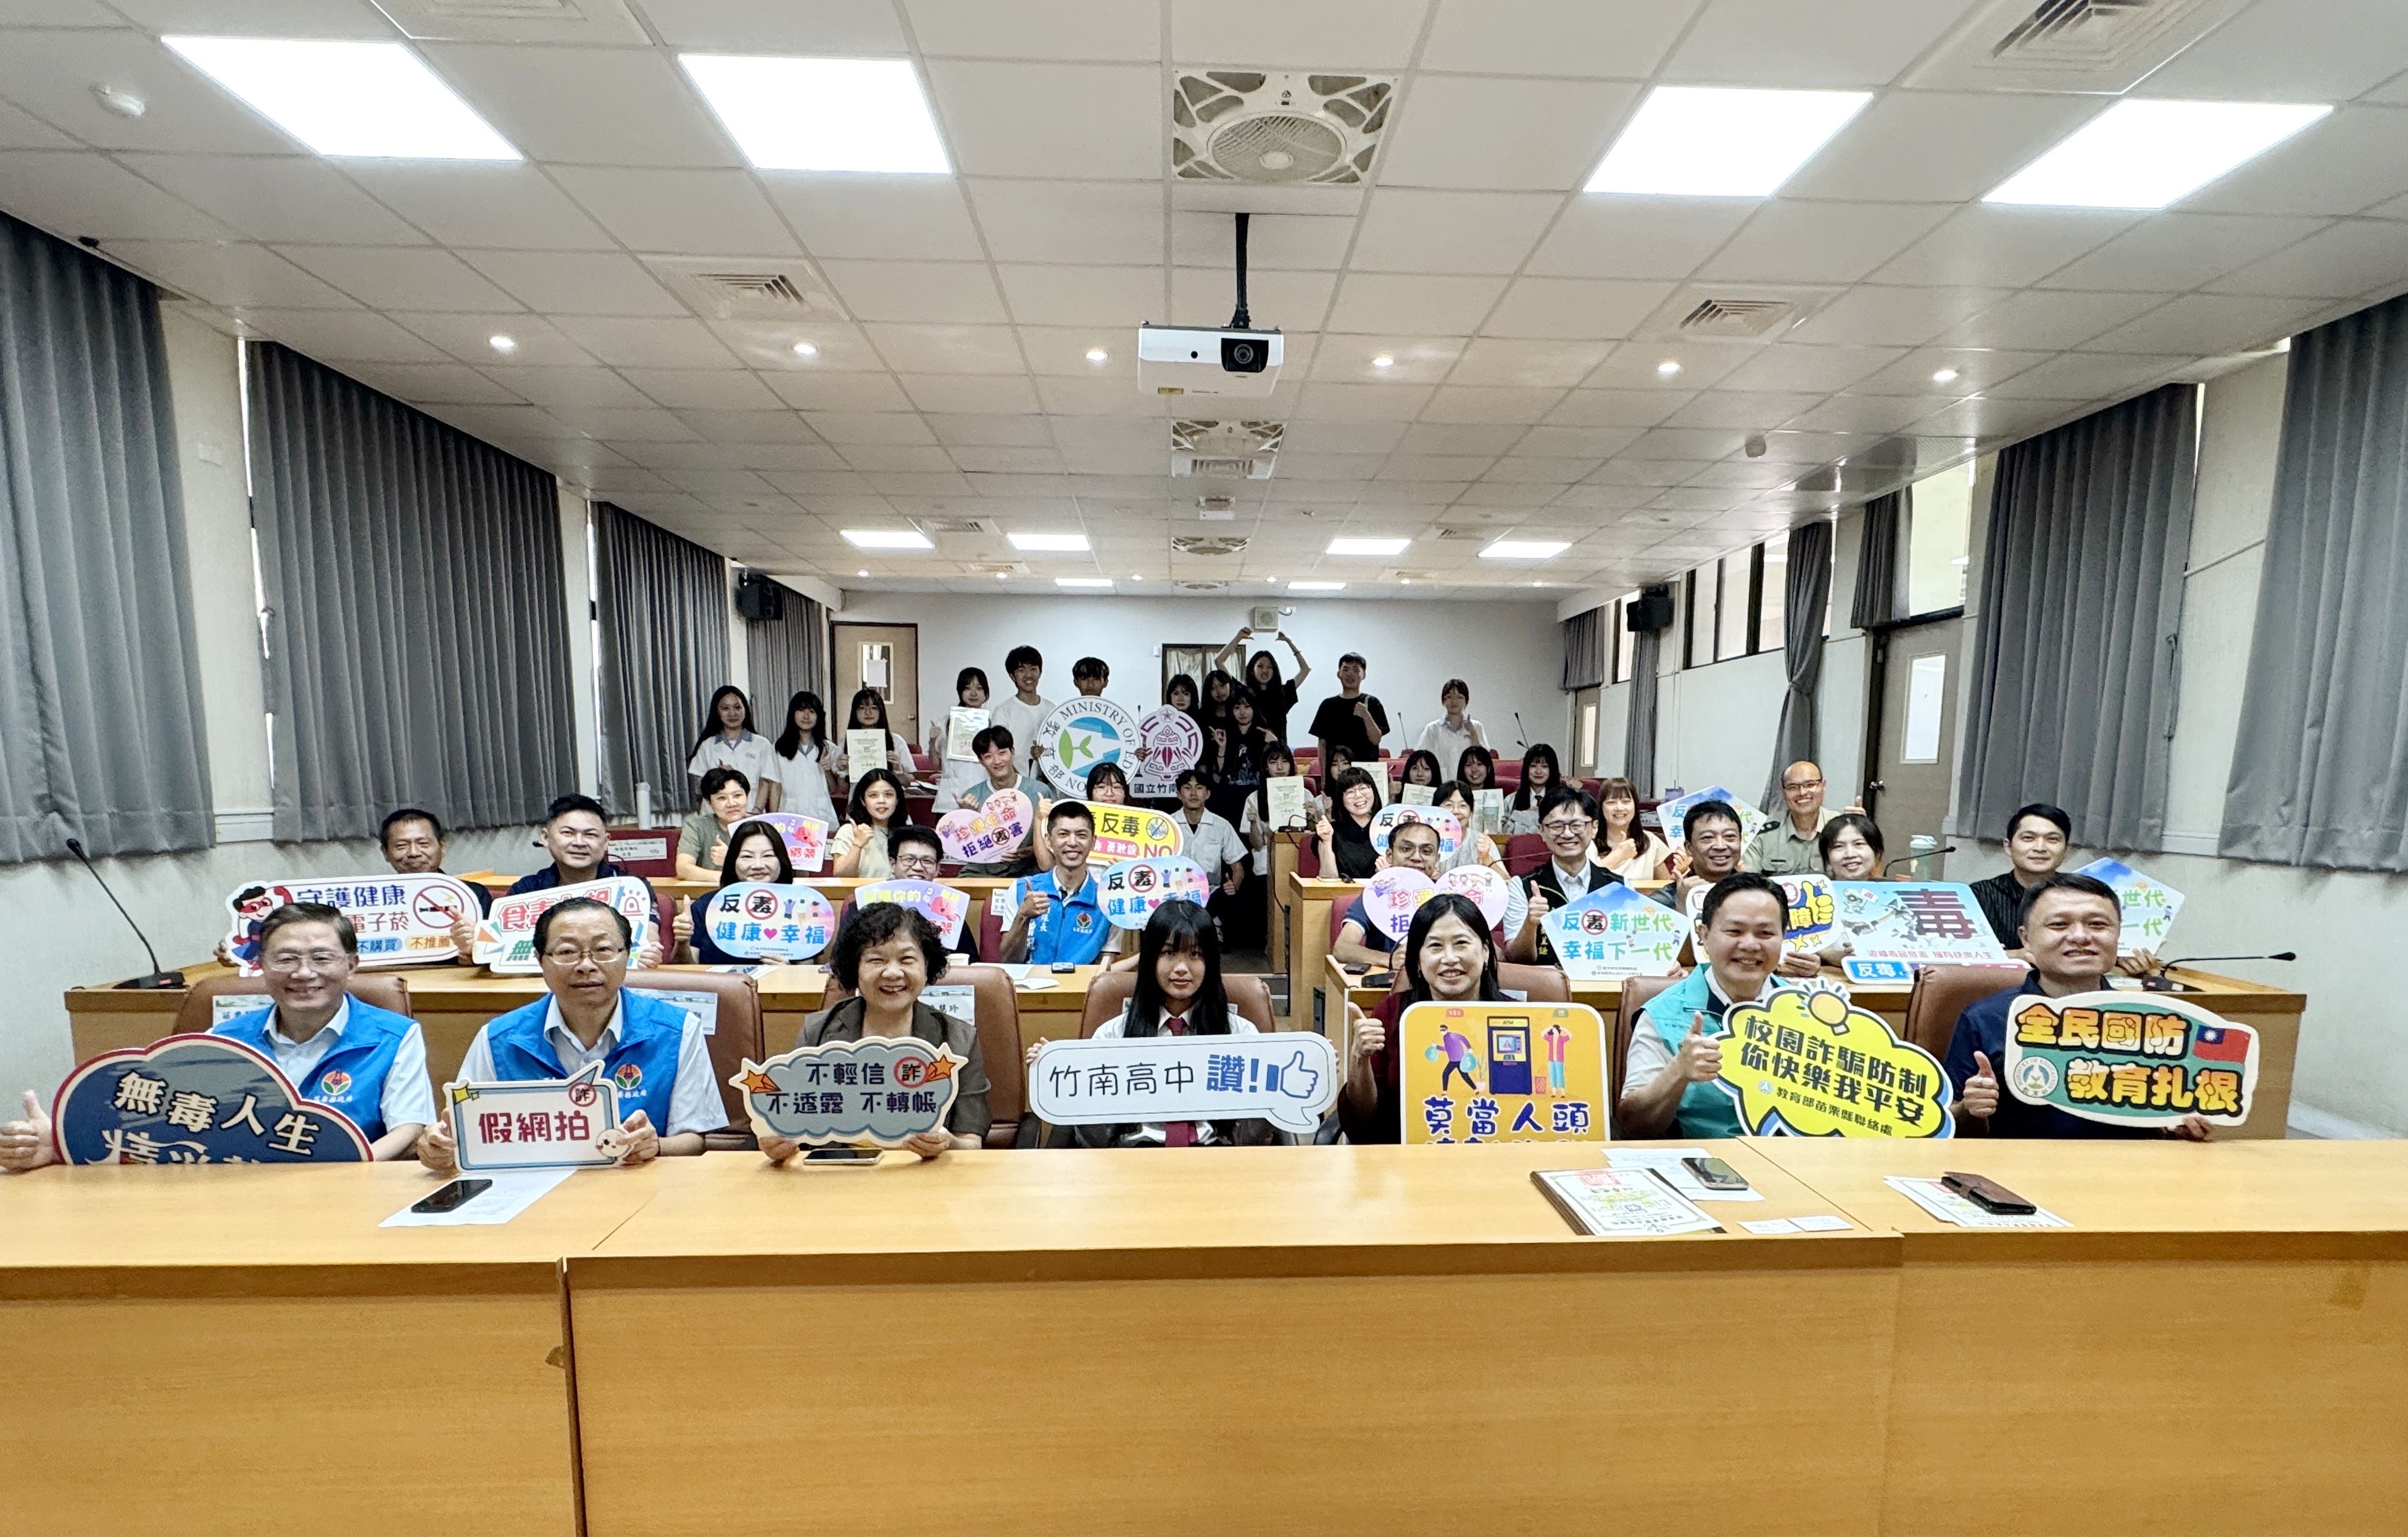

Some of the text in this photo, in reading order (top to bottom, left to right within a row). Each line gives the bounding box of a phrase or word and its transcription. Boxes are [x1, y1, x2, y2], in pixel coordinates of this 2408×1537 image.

[1059, 701, 1127, 727] MINISTRY
[1123, 728, 1135, 746] OF
[1090, 812, 1140, 837] 反毒
[1144, 843, 1173, 859] NO
[1108, 894, 1147, 917] 健康
[1562, 911, 1672, 933] 反毒新世代
[716, 920, 824, 944] 健康 幸福
[1562, 940, 1673, 962] 幸福下一代
[2016, 1003, 2189, 1057] 全民國防
[805, 1062, 921, 1085] 不輕信 詐
[1745, 1015, 1928, 1099] 校園詐騙防制
[1049, 1060, 1194, 1098] 竹南高中
[1741, 1042, 1925, 1128] 你快樂我平安
[2067, 1058, 2240, 1113] 教育扎根
[115, 1072, 320, 1156] 無毒人生
[766, 1091, 936, 1114] 不透露 不轉帳
[1424, 1096, 1589, 1135] 莫當人頭
[478, 1110, 591, 1144] 假網拍
